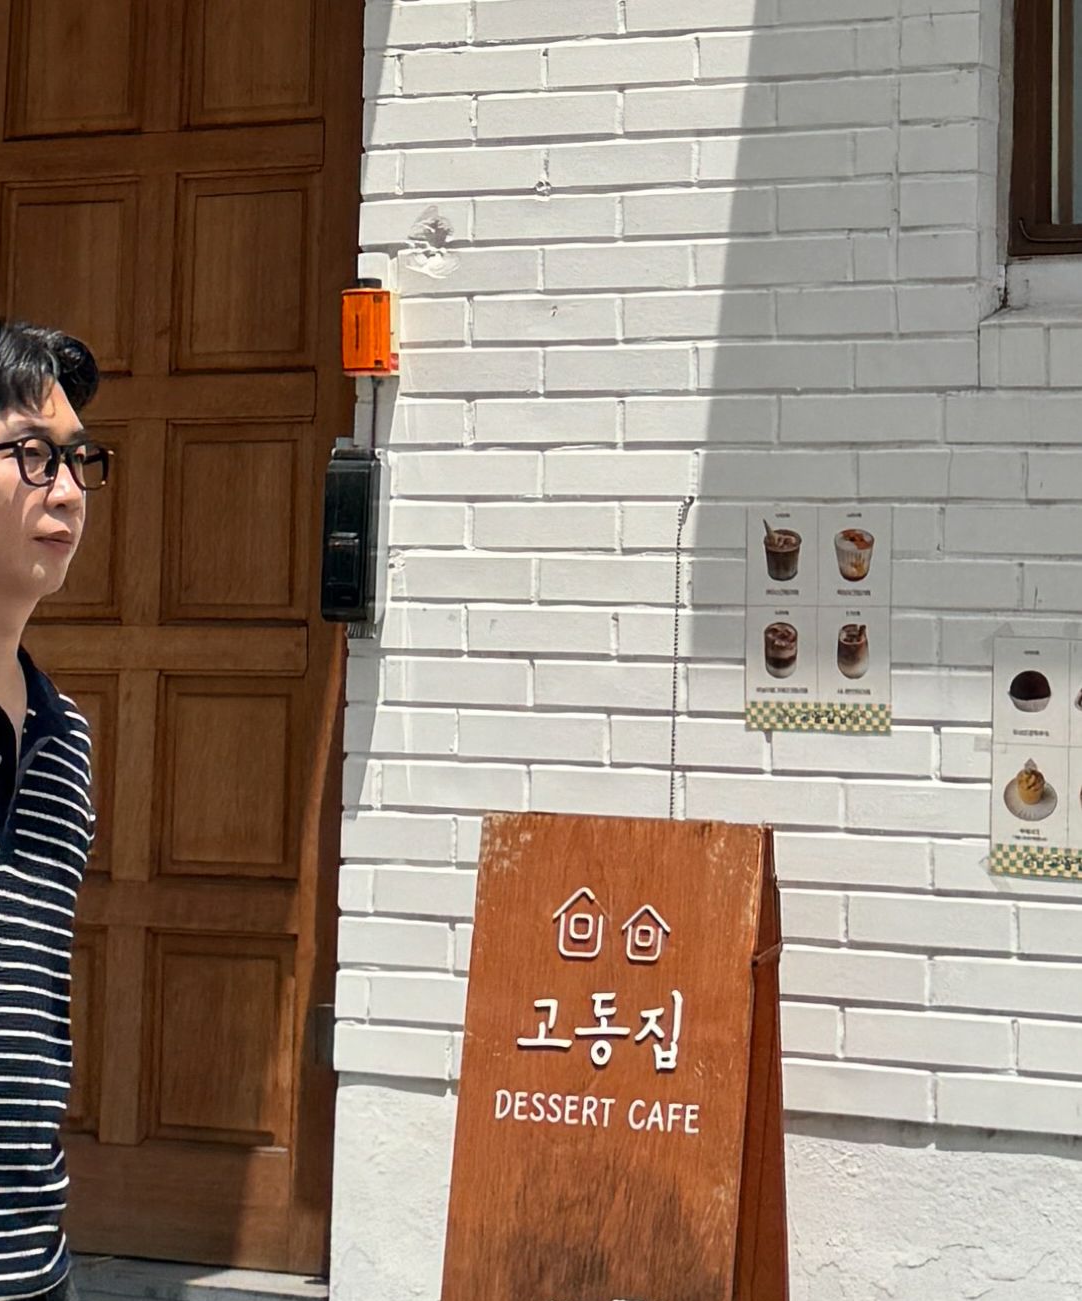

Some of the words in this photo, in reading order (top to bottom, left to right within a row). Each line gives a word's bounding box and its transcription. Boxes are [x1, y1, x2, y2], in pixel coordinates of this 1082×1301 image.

[516, 989, 684, 1070] 고동집
[494, 1088, 616, 1128] DESSERT
[627, 1099, 700, 1134] CAFE
